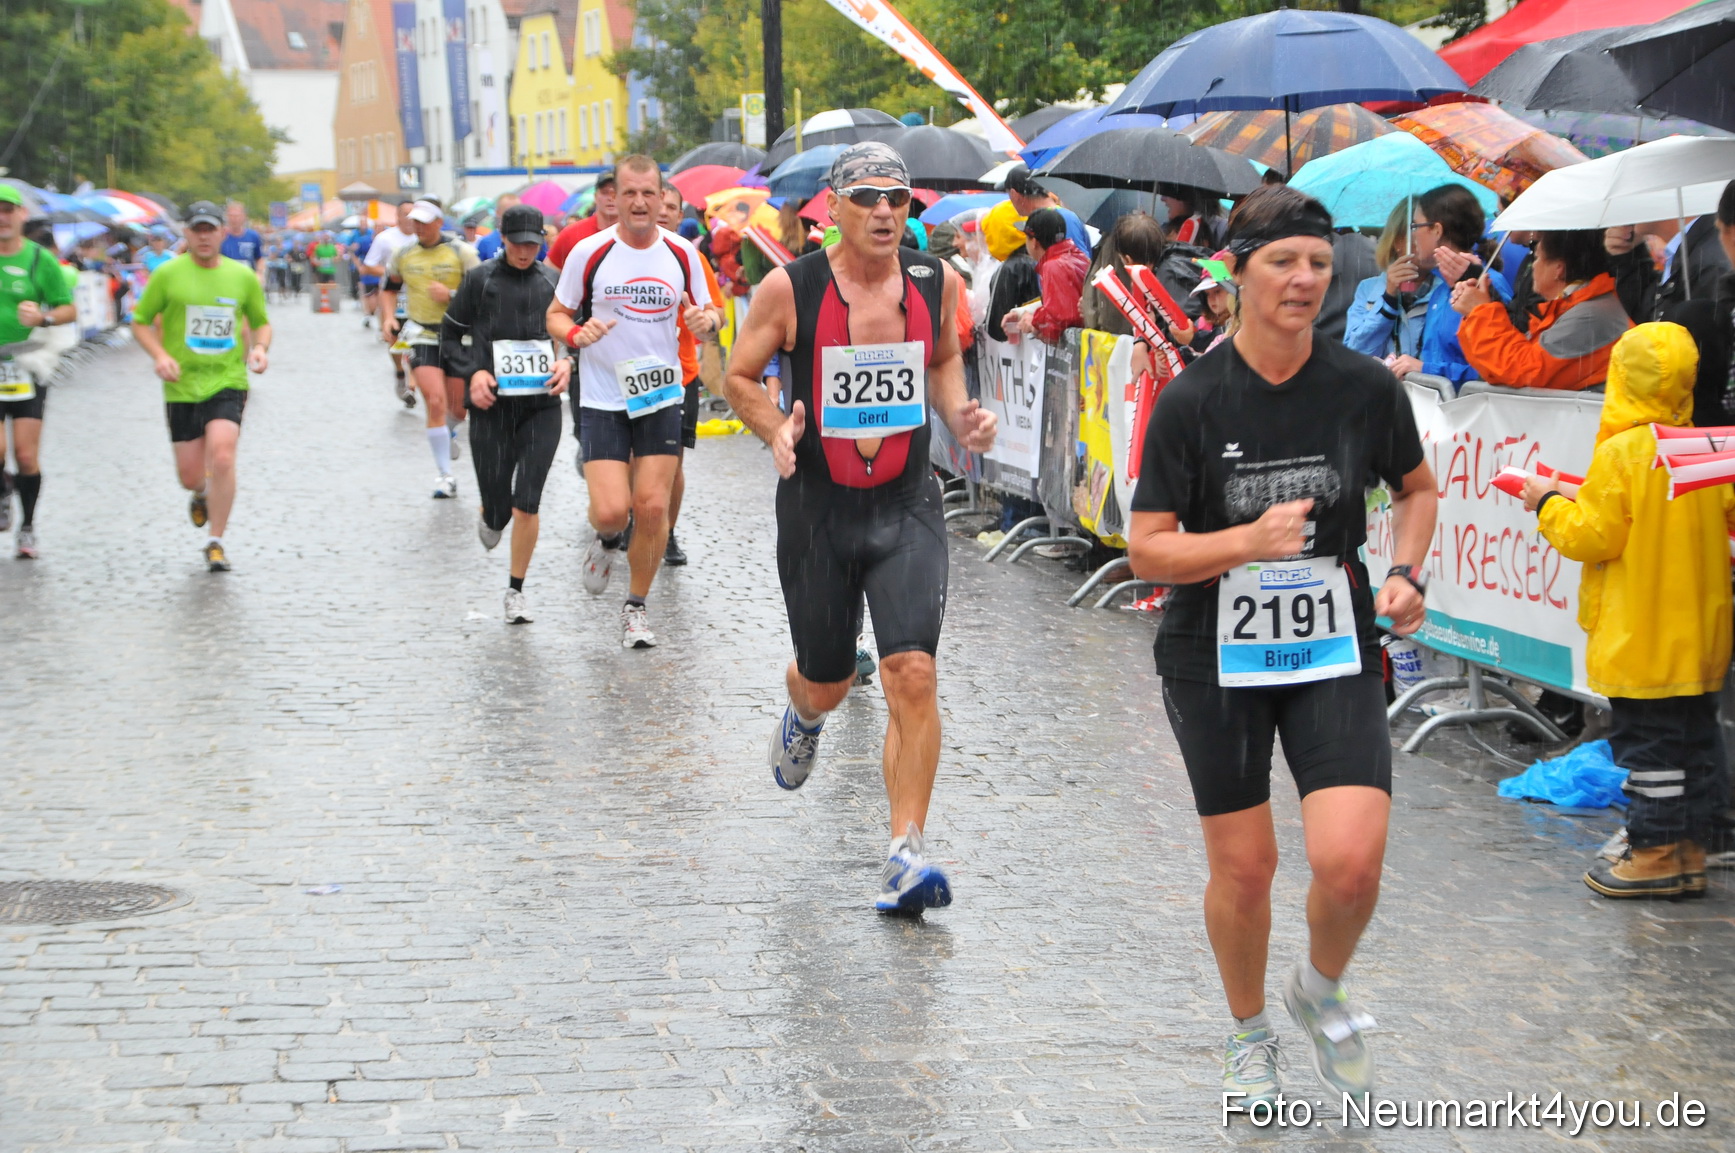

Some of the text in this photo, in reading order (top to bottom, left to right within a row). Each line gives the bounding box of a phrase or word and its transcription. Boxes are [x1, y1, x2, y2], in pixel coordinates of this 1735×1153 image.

[604, 285, 664, 295] GERHART
[631, 295, 671, 306] JANIG
[1115, 296, 1180, 370] AUSTRA
[502, 354, 549, 374] 3318
[625, 368, 675, 395] 3090
[833, 368, 915, 404] 3253
[858, 411, 889, 424] Gerd
[1260, 567, 1312, 582] BOCK
[1455, 523, 1567, 610] BESSER.
[1233, 589, 1337, 640] 2191
[1265, 648, 1312, 669] Birgit
